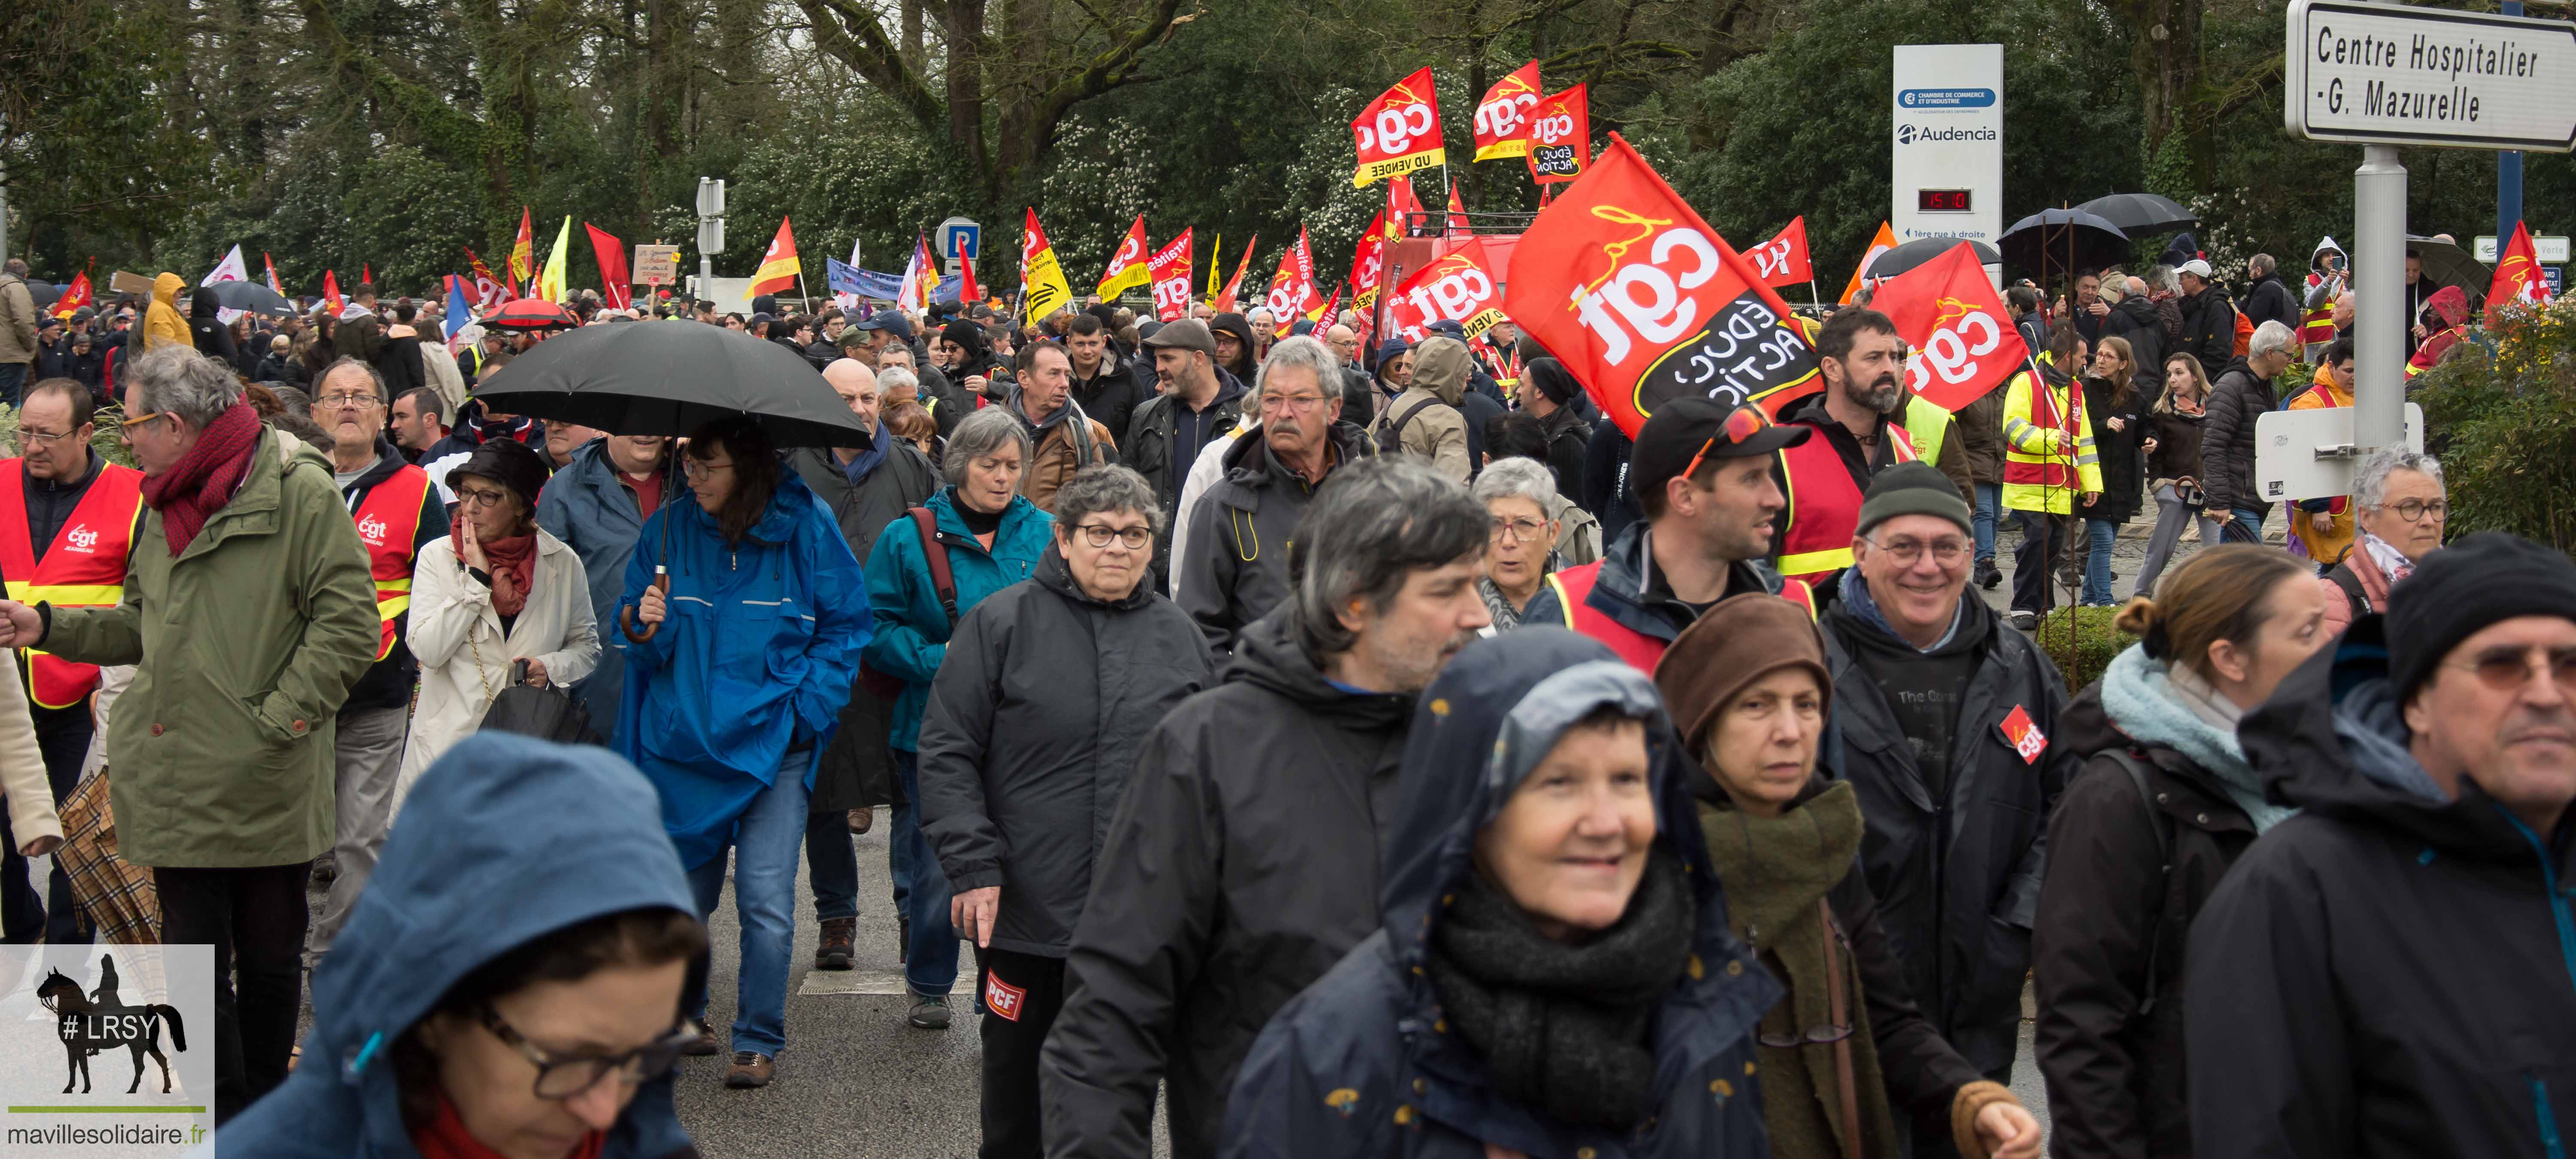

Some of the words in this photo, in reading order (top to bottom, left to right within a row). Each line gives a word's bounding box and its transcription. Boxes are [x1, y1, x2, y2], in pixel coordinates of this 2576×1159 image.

[2318, 26, 2396, 67] Centre
[2410, 33, 2537, 82] Hospitalier
[2365, 80, 2479, 122] Mazurelle
[1920, 126, 1996, 141] Audencia
[476, 277, 511, 306] gt
[68, 532, 98, 547] cgt
[359, 522, 386, 538] cgt
[362, 538, 383, 546] ANNEAU
[2017, 723, 2045, 757] cgt
[988, 981, 1015, 1010] PCF
